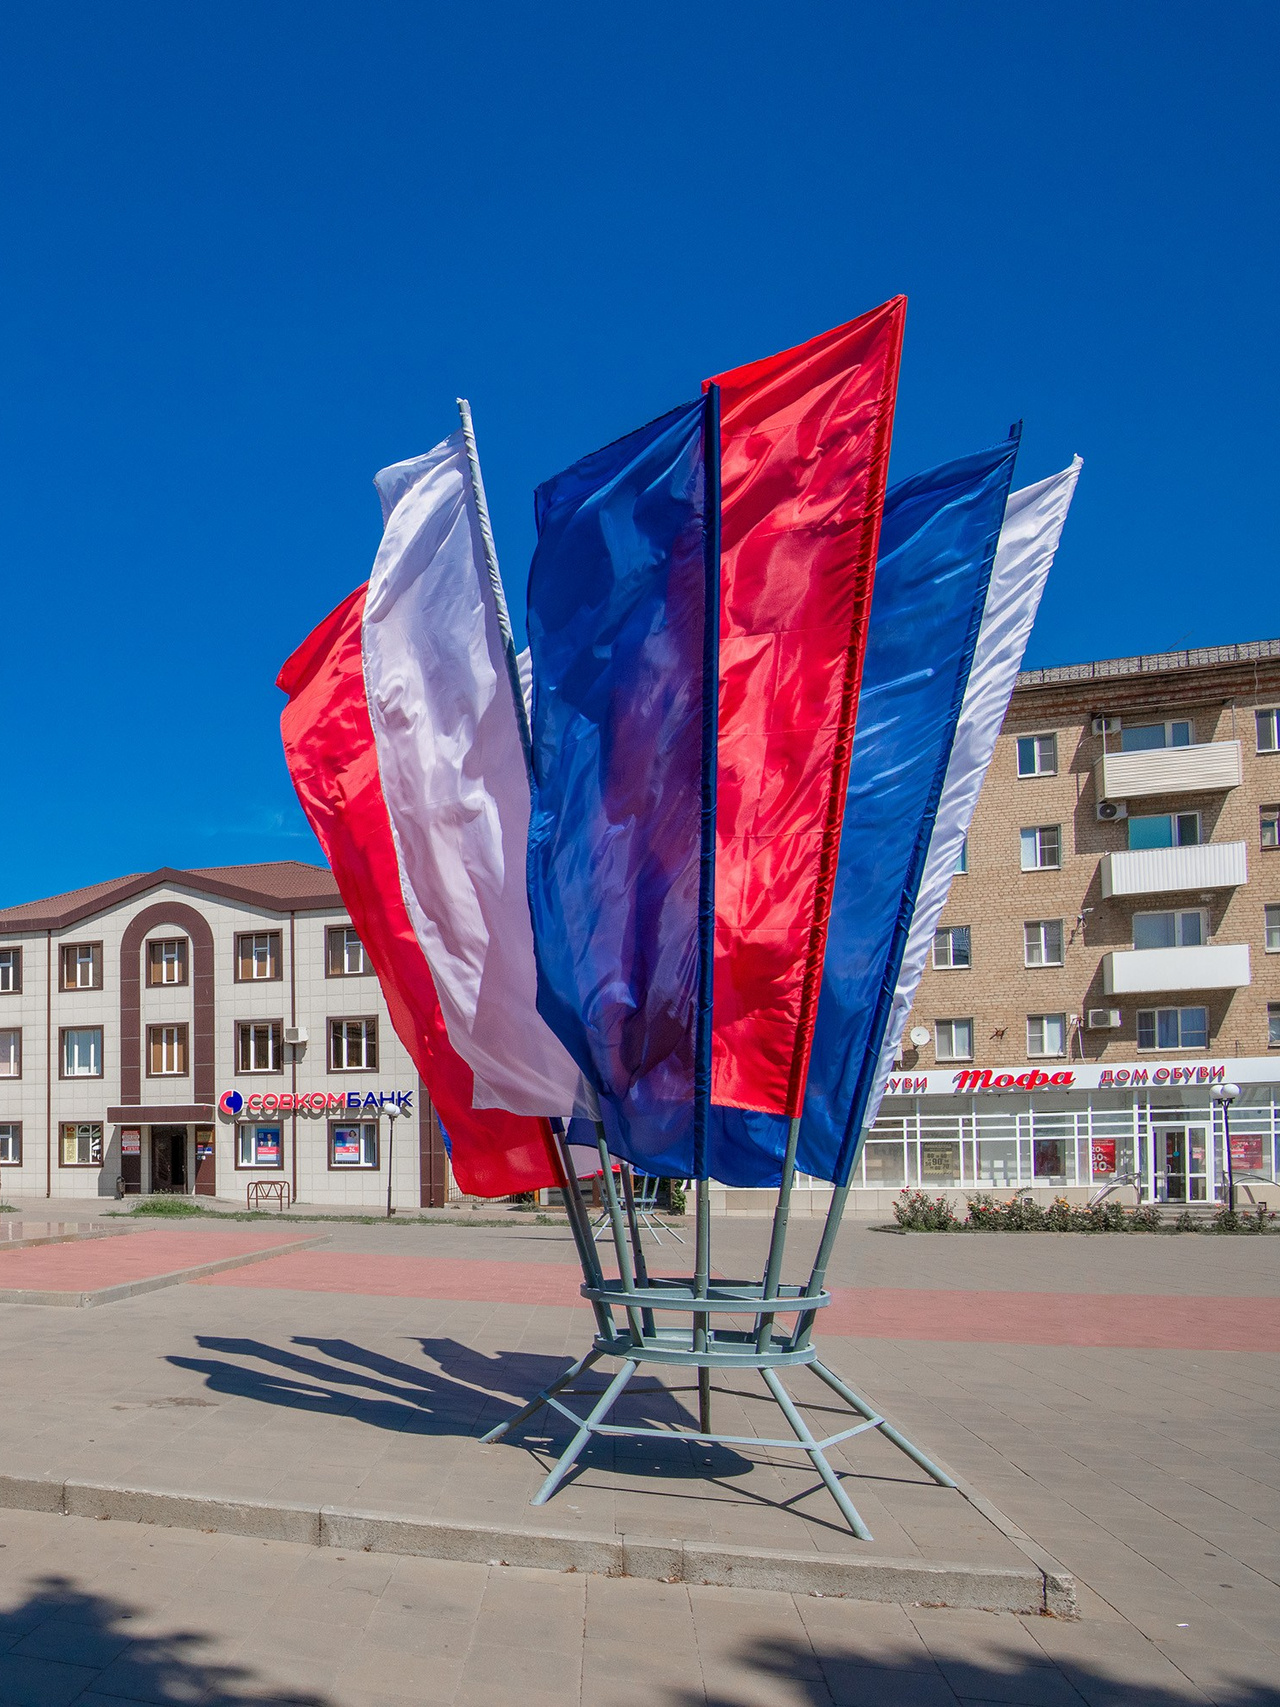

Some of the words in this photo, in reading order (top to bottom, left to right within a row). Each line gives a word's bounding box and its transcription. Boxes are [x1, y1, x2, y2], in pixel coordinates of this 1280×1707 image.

[1101, 1069, 1149, 1084] ДОМ
[1156, 1065, 1226, 1081] ОБУВИ
[247, 1091, 414, 1110] СОВКОМБАНК
